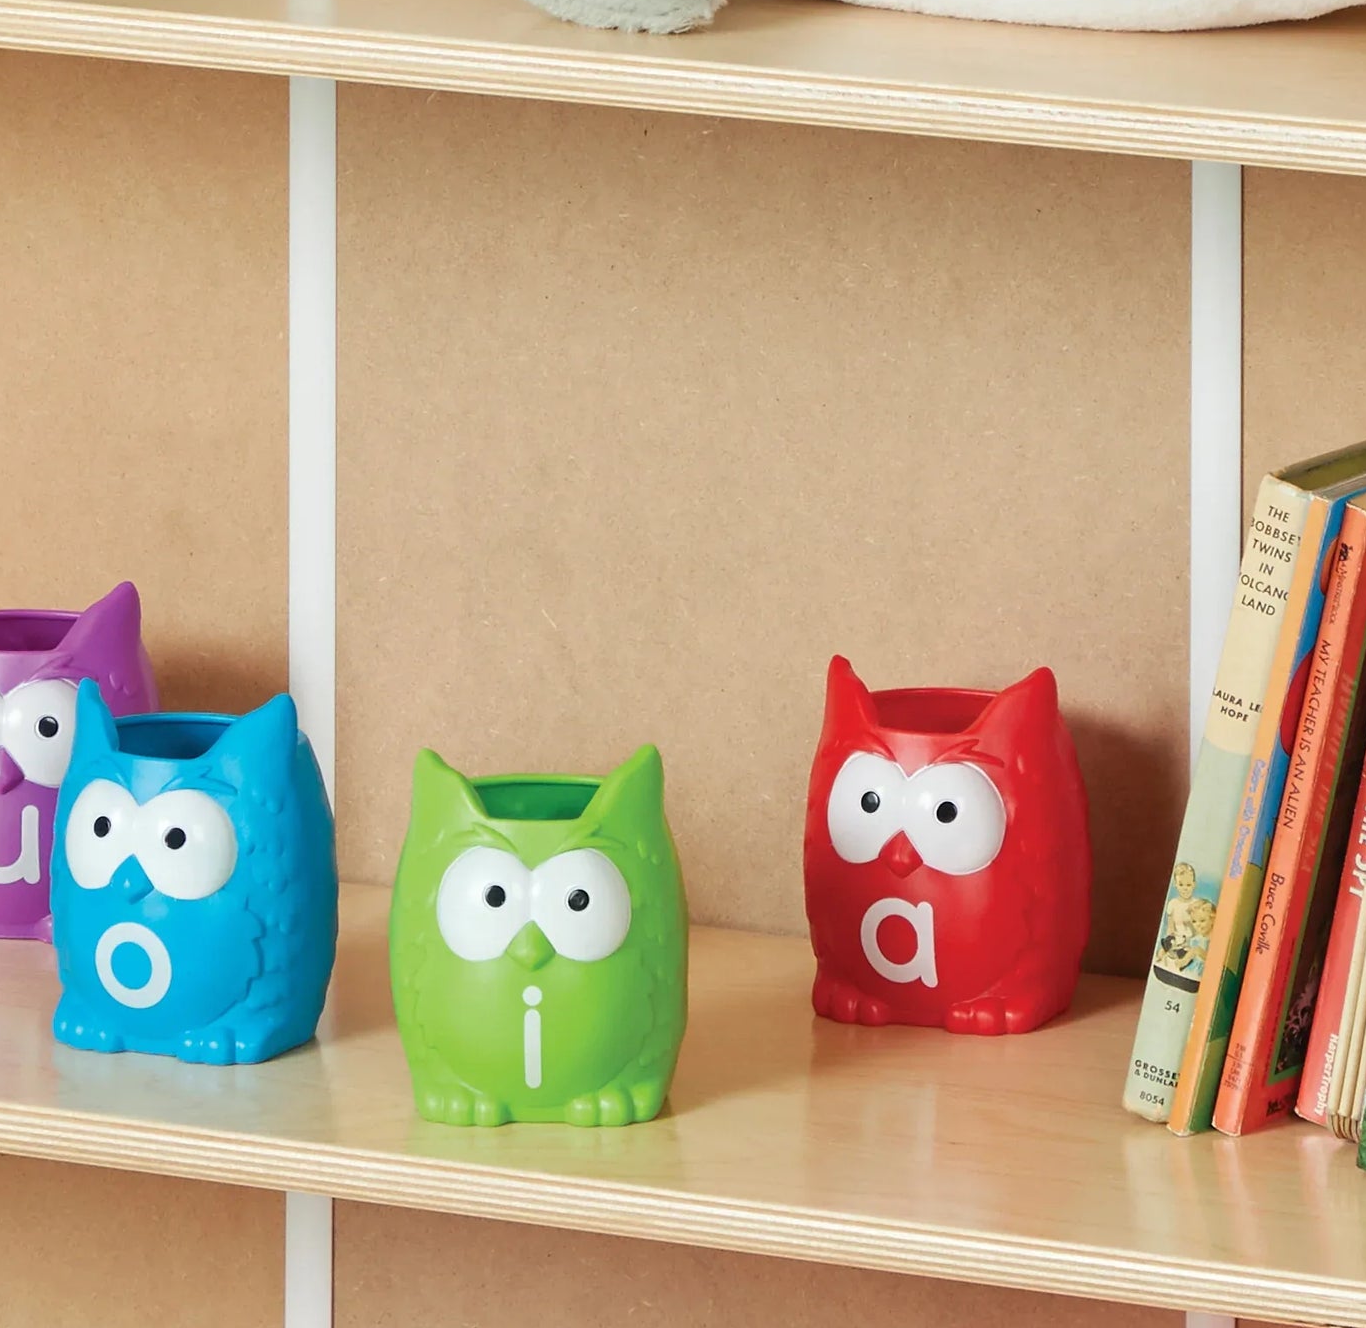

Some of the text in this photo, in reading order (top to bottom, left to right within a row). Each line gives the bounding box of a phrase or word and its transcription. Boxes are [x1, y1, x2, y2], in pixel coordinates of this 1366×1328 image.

[1267, 504, 1291, 524] THE
[1251, 537, 1292, 563] TWINS
[1258, 562, 1275, 576] IN
[1240, 595, 1276, 617] LAND
[1220, 704, 1250, 724] HOPE
[1283, 639, 1332, 830] MY TEACHER IS AN ALIEN
[1254, 872, 1285, 955] Bruce Coville
[860, 896, 939, 988] a
[94, 921, 172, 1009] o
[1164, 999, 1181, 1014] 54
[522, 984, 543, 1089] i
[1314, 1032, 1339, 1118] HarperTrophy
[1138, 1090, 1166, 1108] 8054
